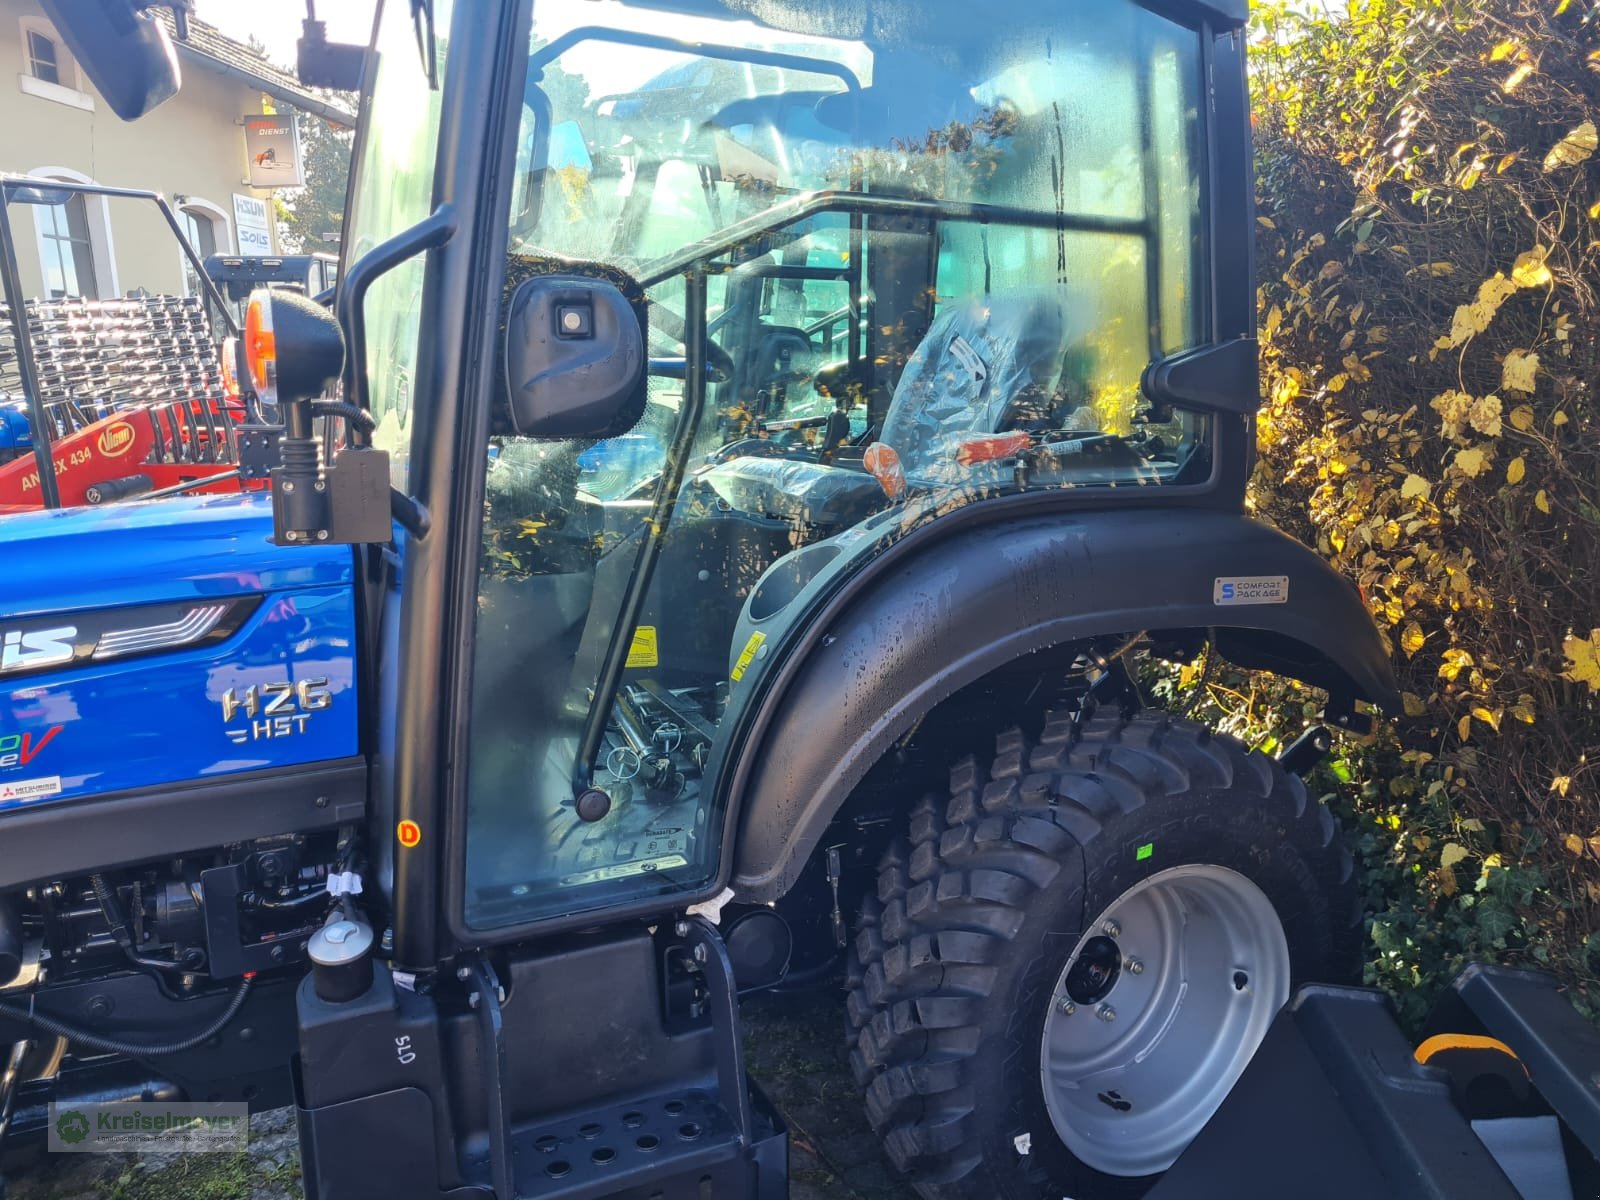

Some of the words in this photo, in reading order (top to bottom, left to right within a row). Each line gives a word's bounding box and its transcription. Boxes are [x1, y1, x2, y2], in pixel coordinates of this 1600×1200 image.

[259, 127, 289, 136] DIENST
[70, 446, 92, 465] 434
[1237, 582, 1281, 590] COMFORT
[1237, 590, 1281, 598] PACKAGE
[253, 713, 311, 740] HST
